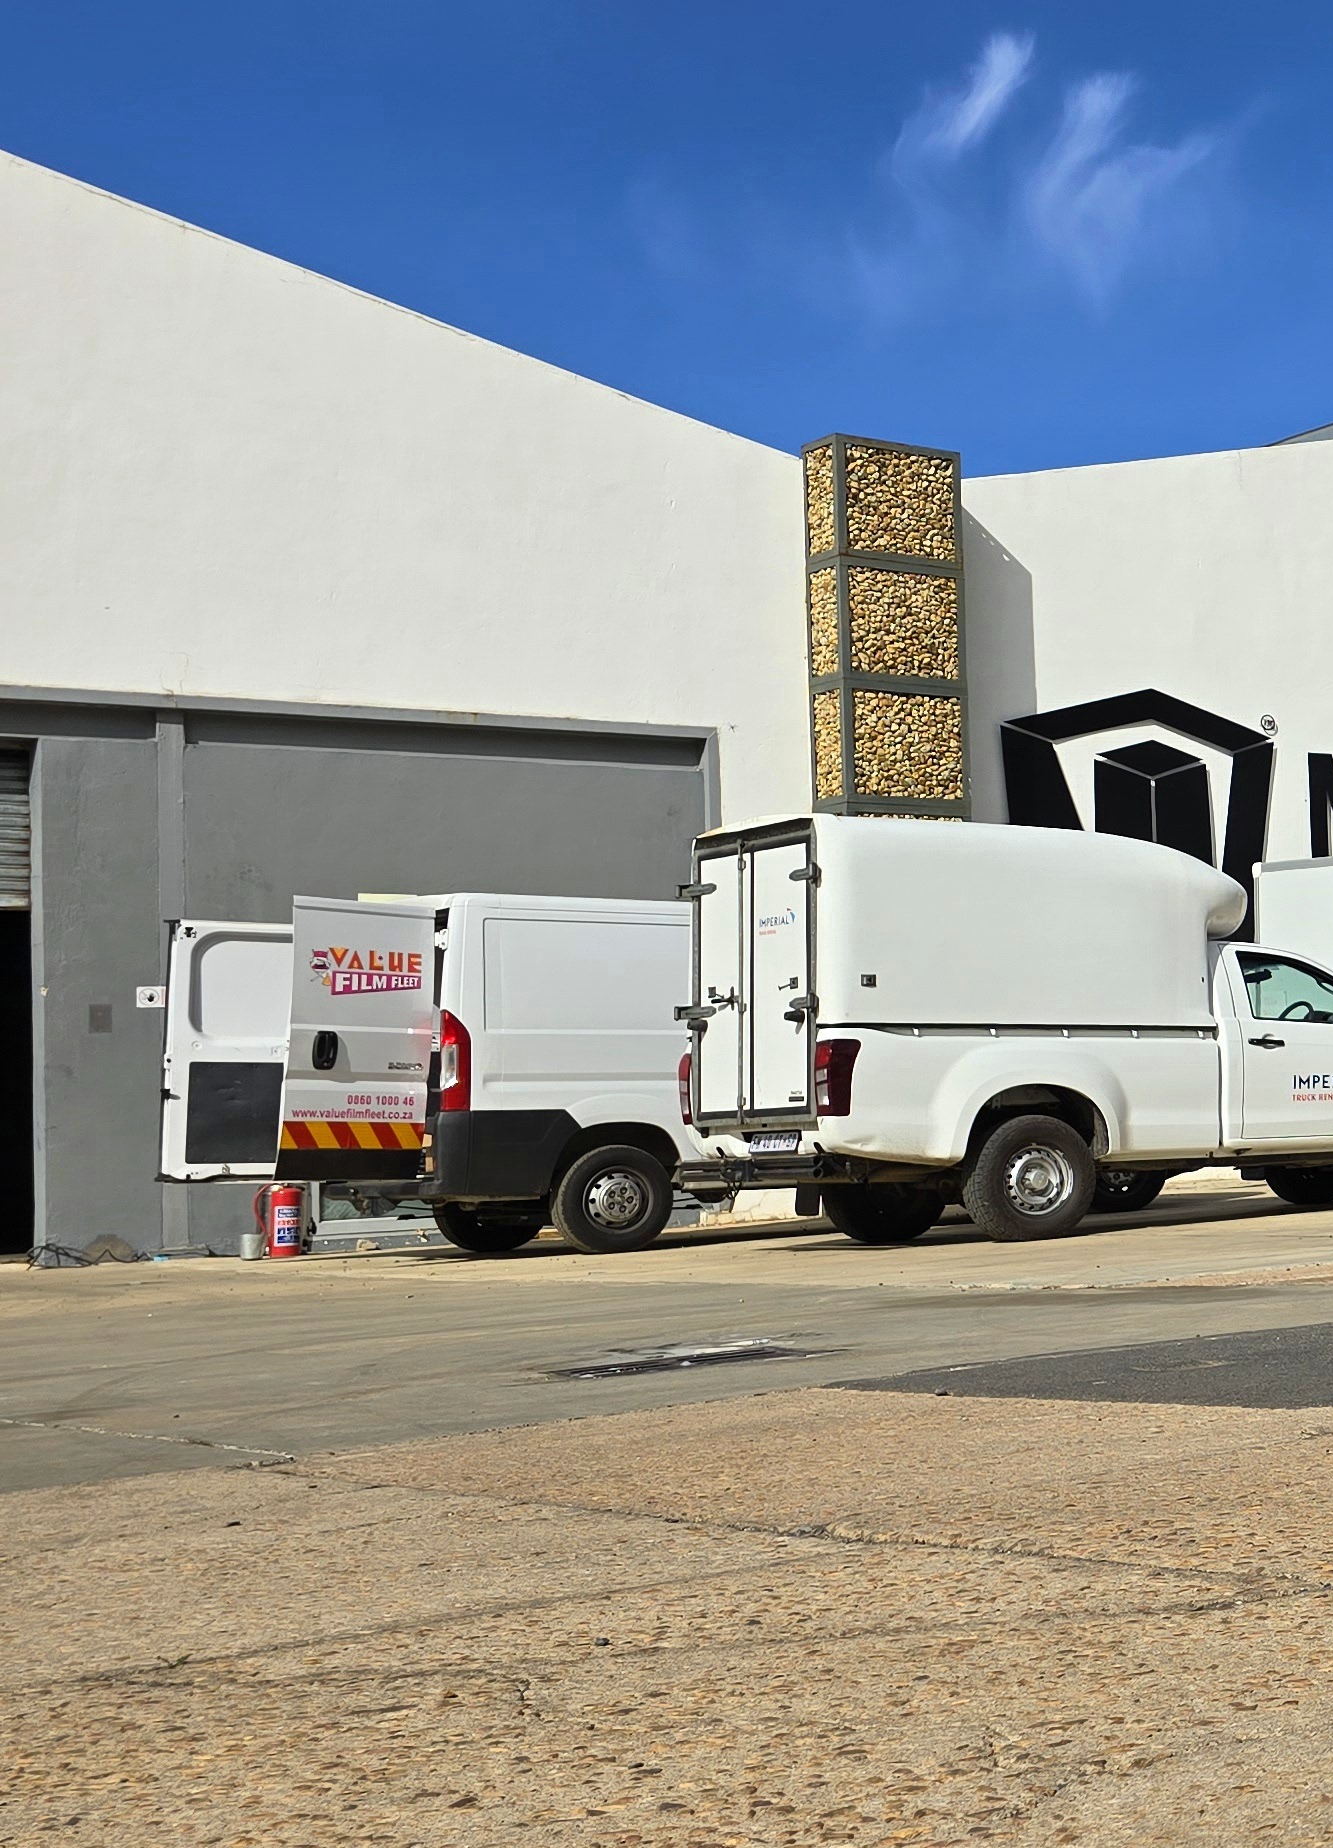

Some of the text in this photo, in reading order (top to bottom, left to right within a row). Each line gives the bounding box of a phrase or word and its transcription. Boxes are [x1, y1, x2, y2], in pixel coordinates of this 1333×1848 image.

[759, 915, 789, 927] IMPERIAL
[329, 947, 422, 973] VALUE
[335, 972, 419, 991] FILM FLEET
[291, 1108, 413, 1119] www.valuefilmfleet.co.za
